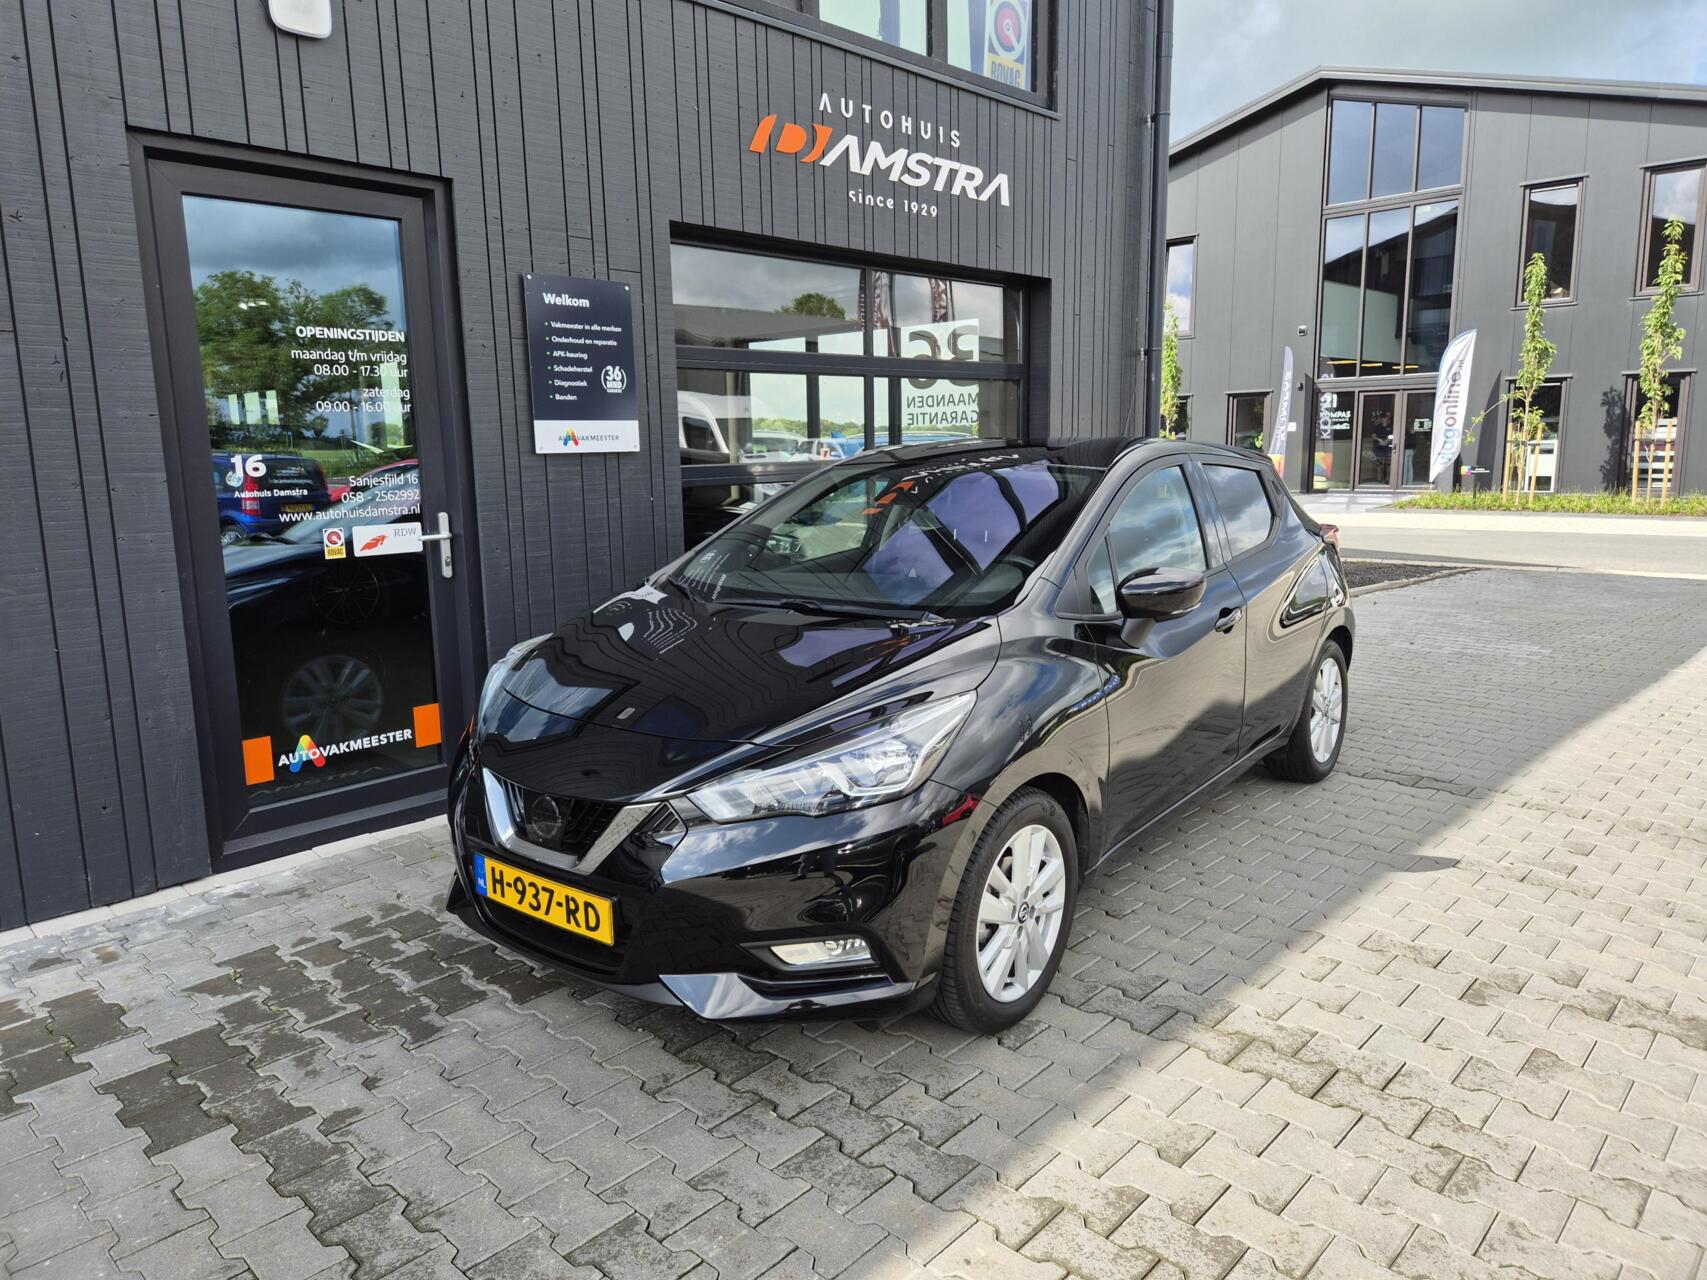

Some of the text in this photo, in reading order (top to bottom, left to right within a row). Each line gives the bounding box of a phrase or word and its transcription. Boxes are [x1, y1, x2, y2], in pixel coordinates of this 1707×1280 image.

[991, 61, 1020, 87] BOVAG
[819, 92, 961, 148] AUTOHUIS
[848, 189, 938, 218] since 1929
[543, 292, 590, 308] Welkom
[550, 321, 584, 330] Vakmeester
[295, 326, 405, 342] OPENINGSTIJDEN
[551, 335, 584, 344] Onderhoud
[291, 348, 407, 365] maandag t/m vrijdag
[553, 351, 588, 360] APK-keuring
[314, 364, 349, 375] 08.00
[553, 365, 592, 373] Schadeherstel
[605, 365, 622, 381] 36
[554, 379, 587, 388] Diagnostiek
[363, 387, 410, 401] zaterdag
[555, 393, 577, 401] Banden
[316, 401, 350, 412] 09.00
[558, 434, 619, 442] AUTOVAKMEESTER
[231, 454, 267, 478] 16
[406, 473, 418, 485] 16
[234, 488, 308, 499] Autohuis Damstra
[341, 491, 364, 503] 058
[375, 489, 420, 502] 2562992
[279, 503, 420, 522] www.autohuisdamstra.nl
[393, 527, 417, 537] RDW
[278, 728, 412, 767] AUTOVAKMEESTER
[478, 876, 486, 889] NL
[490, 866, 600, 933] H-937-RD
